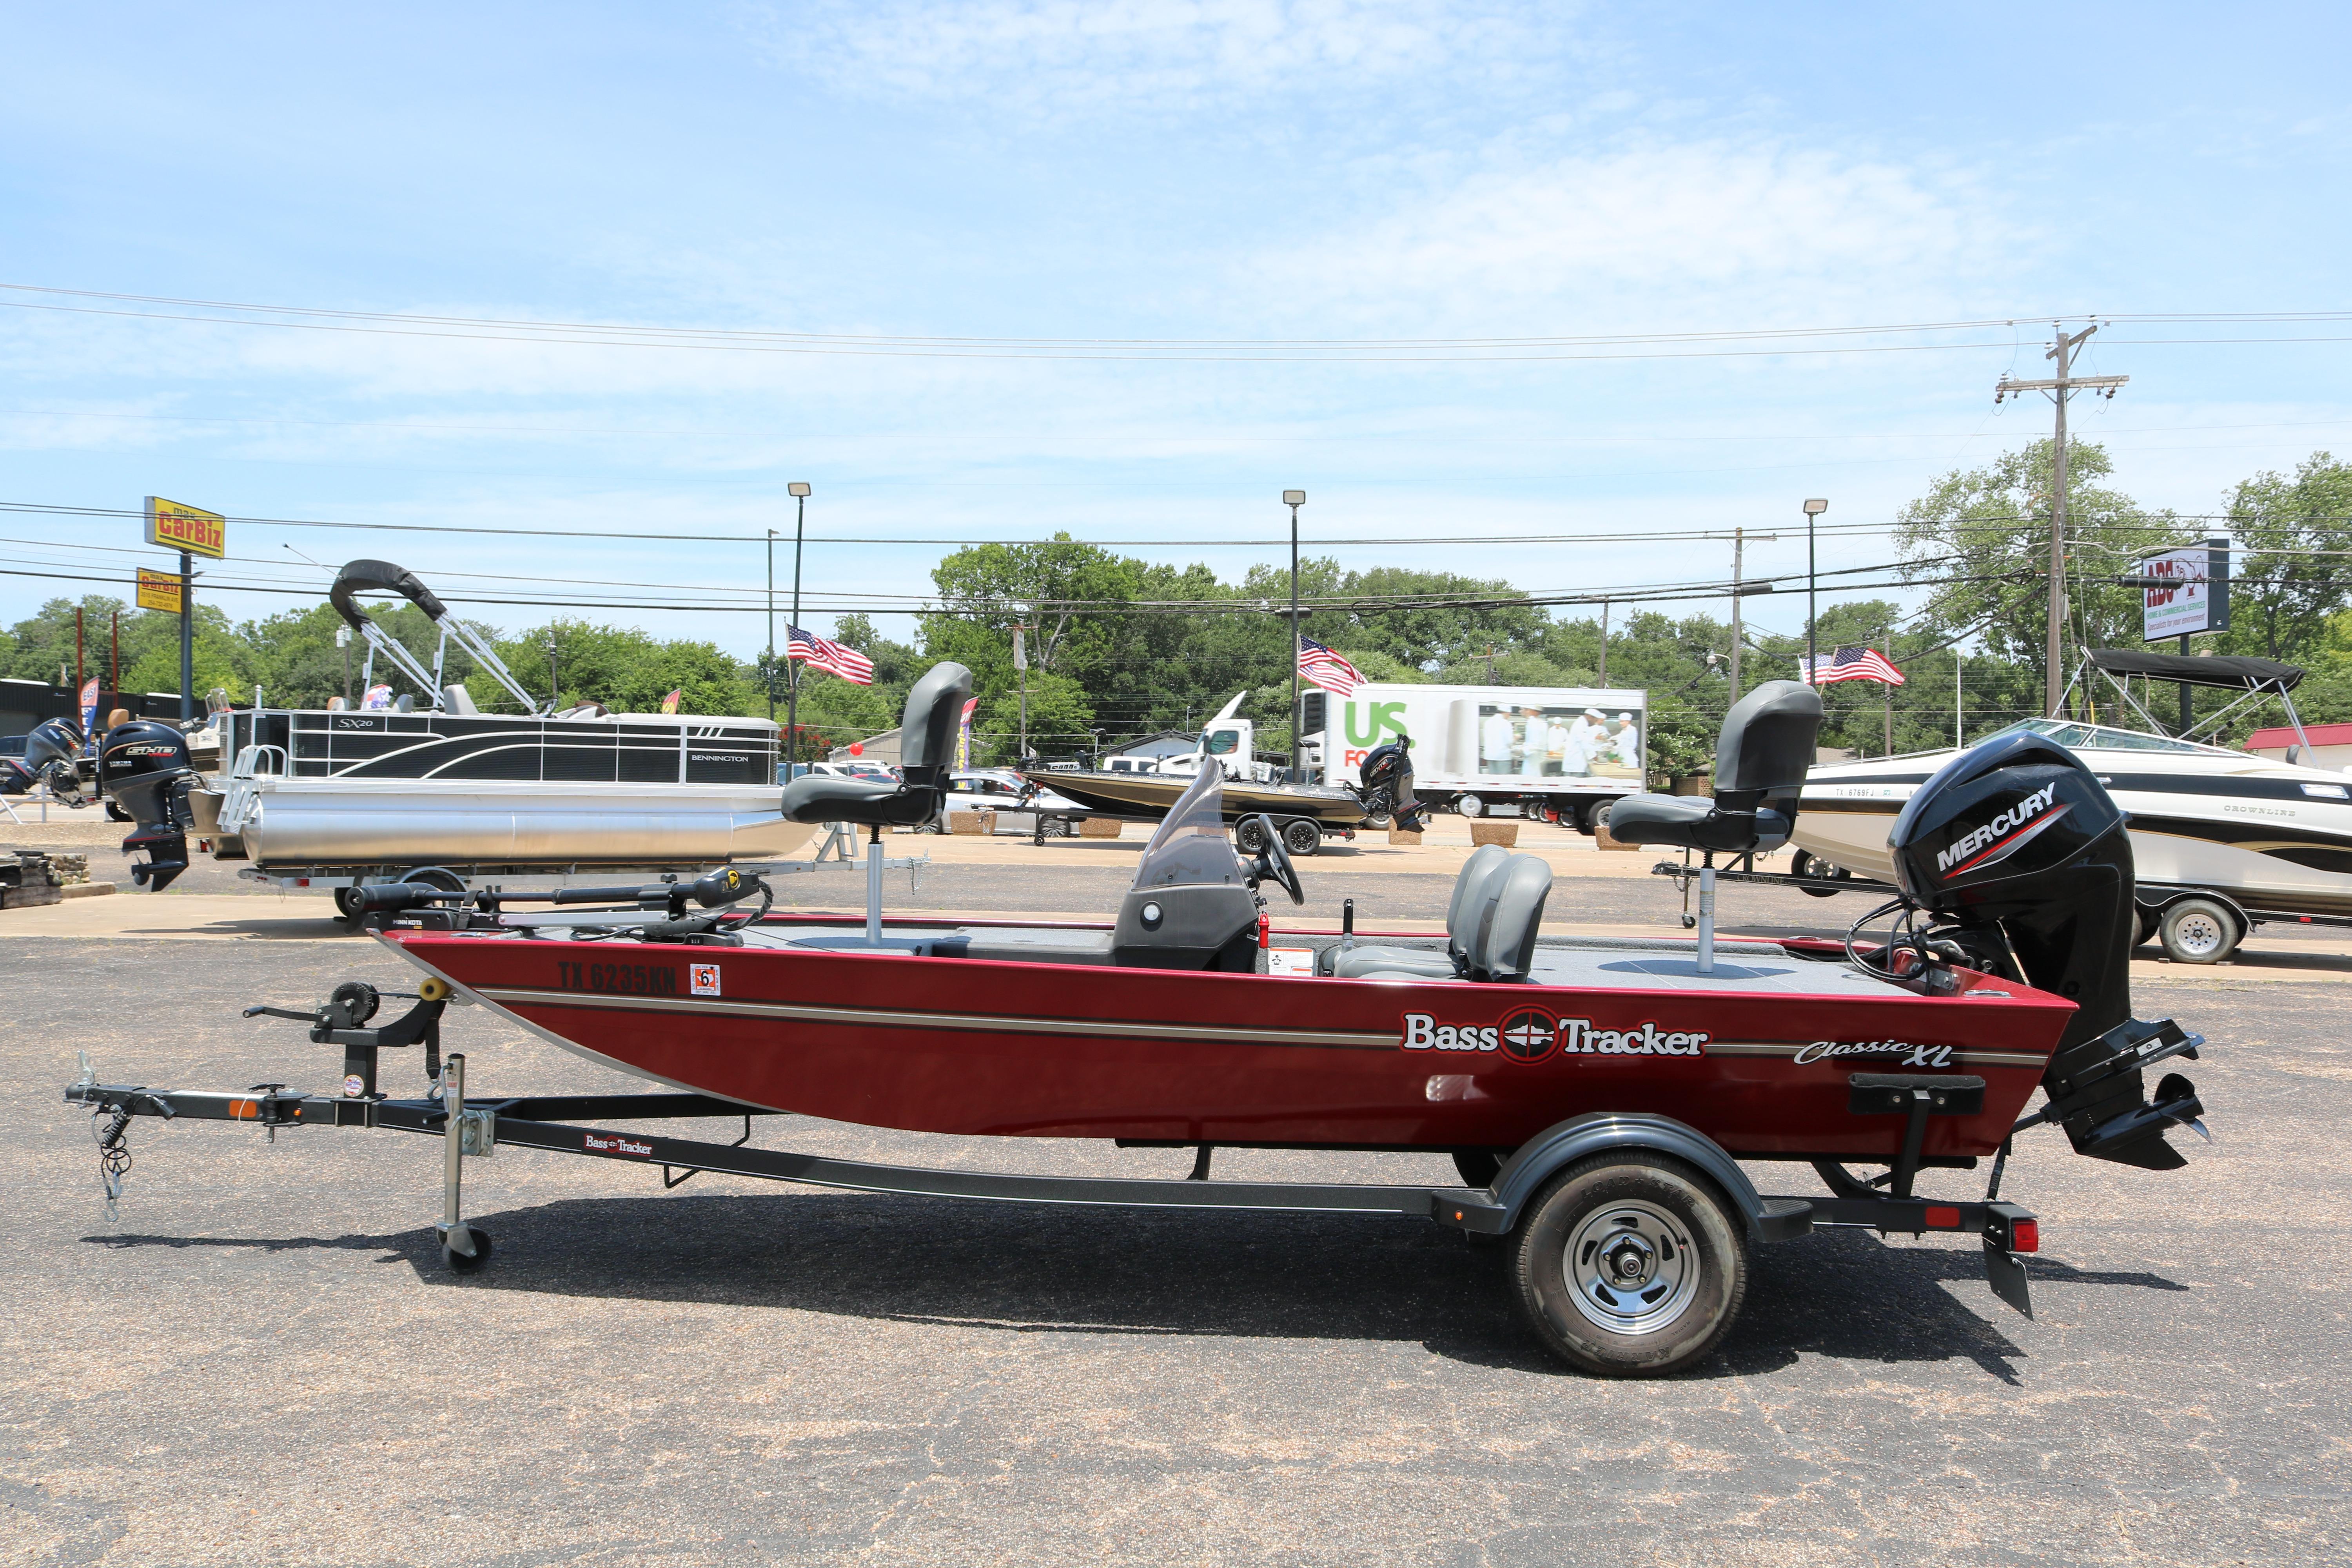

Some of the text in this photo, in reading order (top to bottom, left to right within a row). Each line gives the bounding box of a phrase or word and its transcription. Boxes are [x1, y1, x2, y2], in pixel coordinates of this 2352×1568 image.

[174, 507, 196, 519] max
[159, 510, 221, 548] CarBiz
[142, 576, 179, 593] CarBiz
[151, 593, 171, 601] FRANKLIN
[2147, 610, 2159, 619] HOME
[2161, 605, 2187, 617] COMMERCIAL
[2187, 601, 2205, 611] SERVICES
[2147, 619, 2167, 632] Specialists
[2173, 618, 2181, 628] your
[2181, 613, 2205, 625] environment
[338, 719, 373, 728] SX20
[125, 746, 178, 755] SHO
[2224, 805, 2296, 817] CROWNLINE
[1937, 782, 2055, 871] MERCURY
[1737, 875, 1784, 884] CROWNLINE
[558, 961, 676, 993] TX 6235KN
[701, 971, 709, 986] 6
[1404, 1014, 1708, 1055] Bass Tracker
[1794, 1039, 1953, 1067] Classic XL
[586, 1135, 652, 1154] Bass Tracker
[1581, 1176, 1697, 1208] LOAD STAR
[1580, 1339, 1671, 1362] KARRIER
